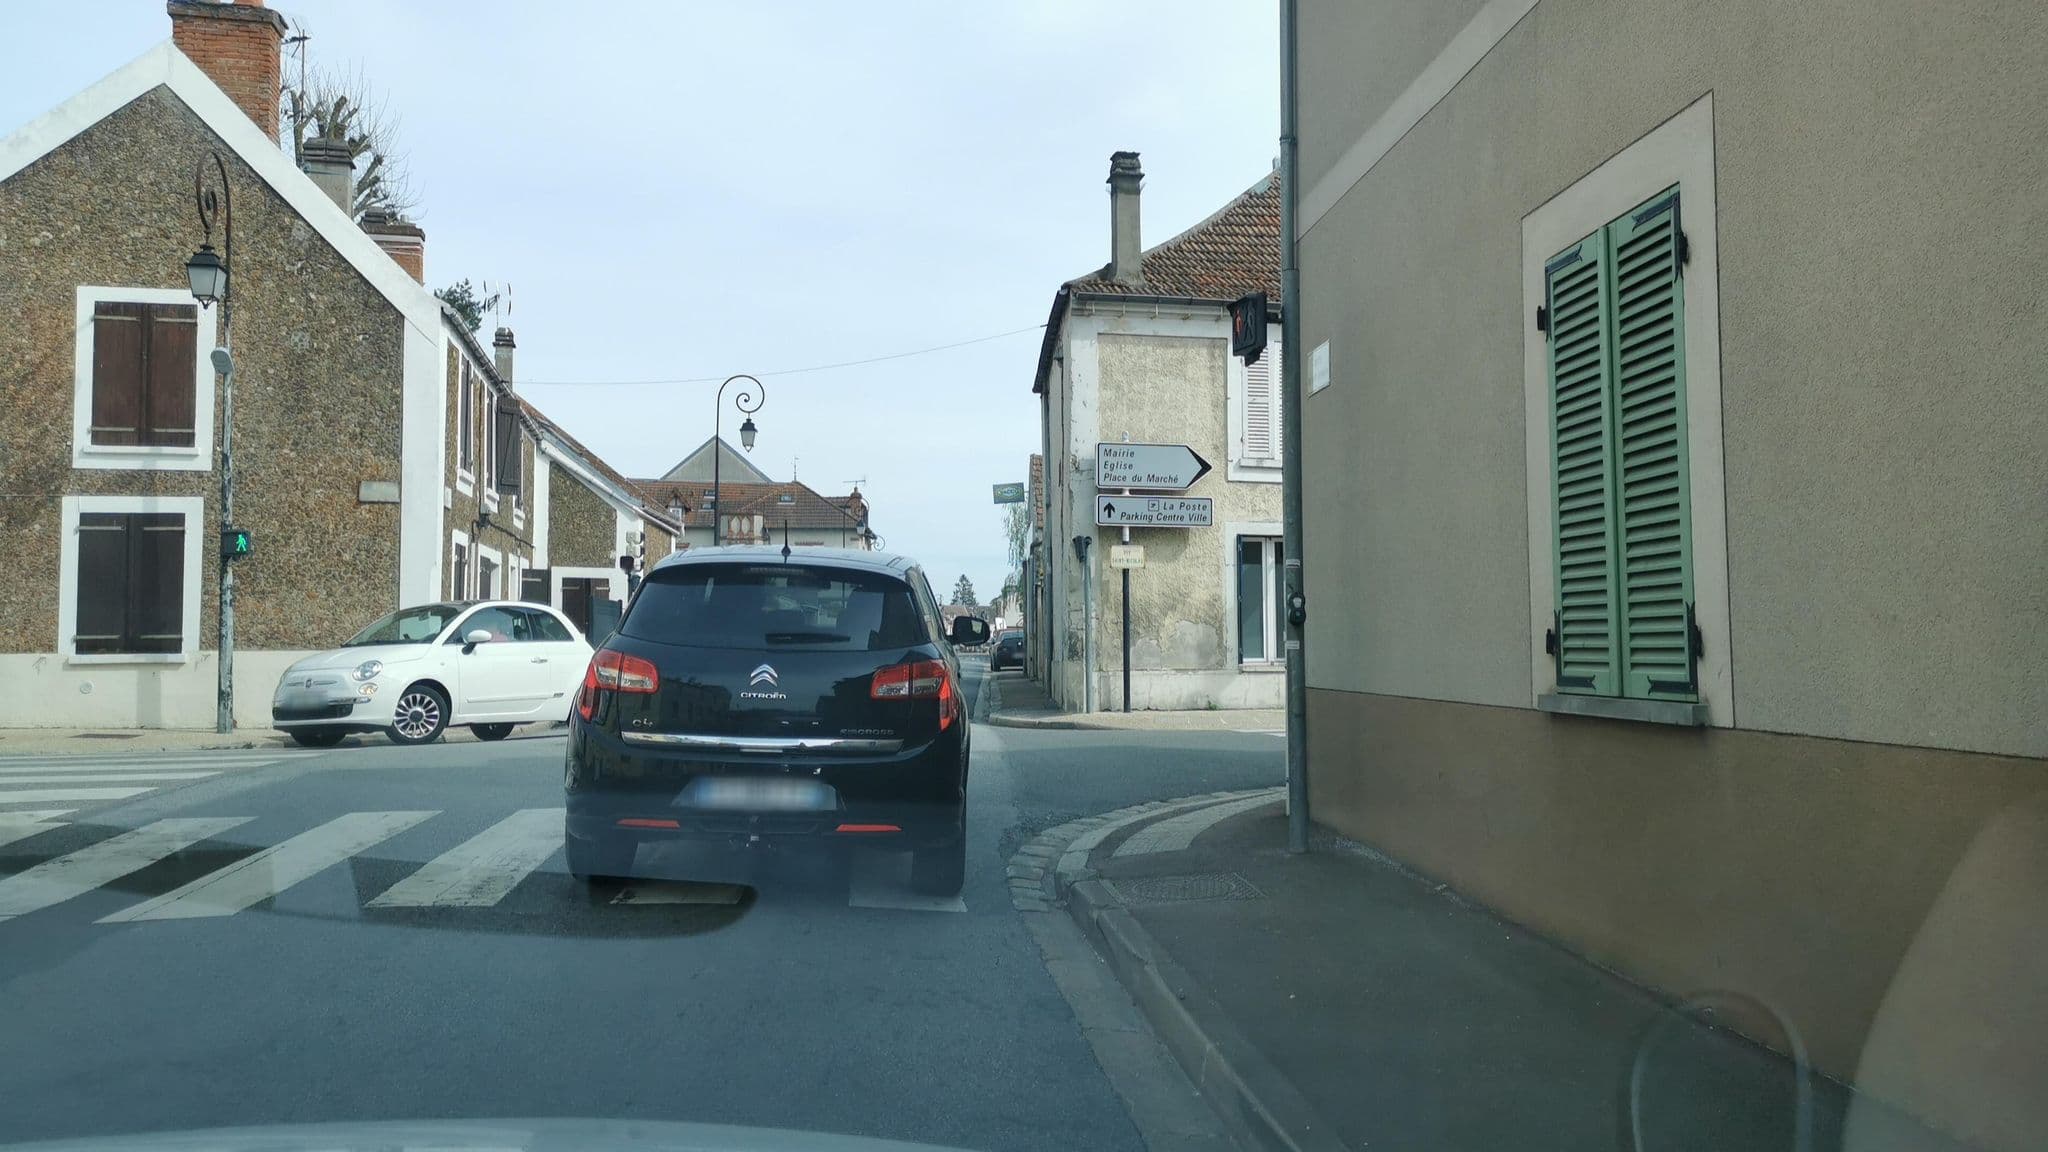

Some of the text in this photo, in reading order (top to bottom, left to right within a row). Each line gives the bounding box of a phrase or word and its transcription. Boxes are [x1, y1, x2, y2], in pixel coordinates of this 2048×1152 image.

[1104, 448, 1135, 458] Mairie
[1104, 461, 1134, 472] Eglise
[1104, 473, 1179, 484] Place du Marché
[1163, 502, 1208, 511] La Poste
[1120, 512, 1208, 523] Parking Centre Ville
[632, 718, 654, 728] C4
